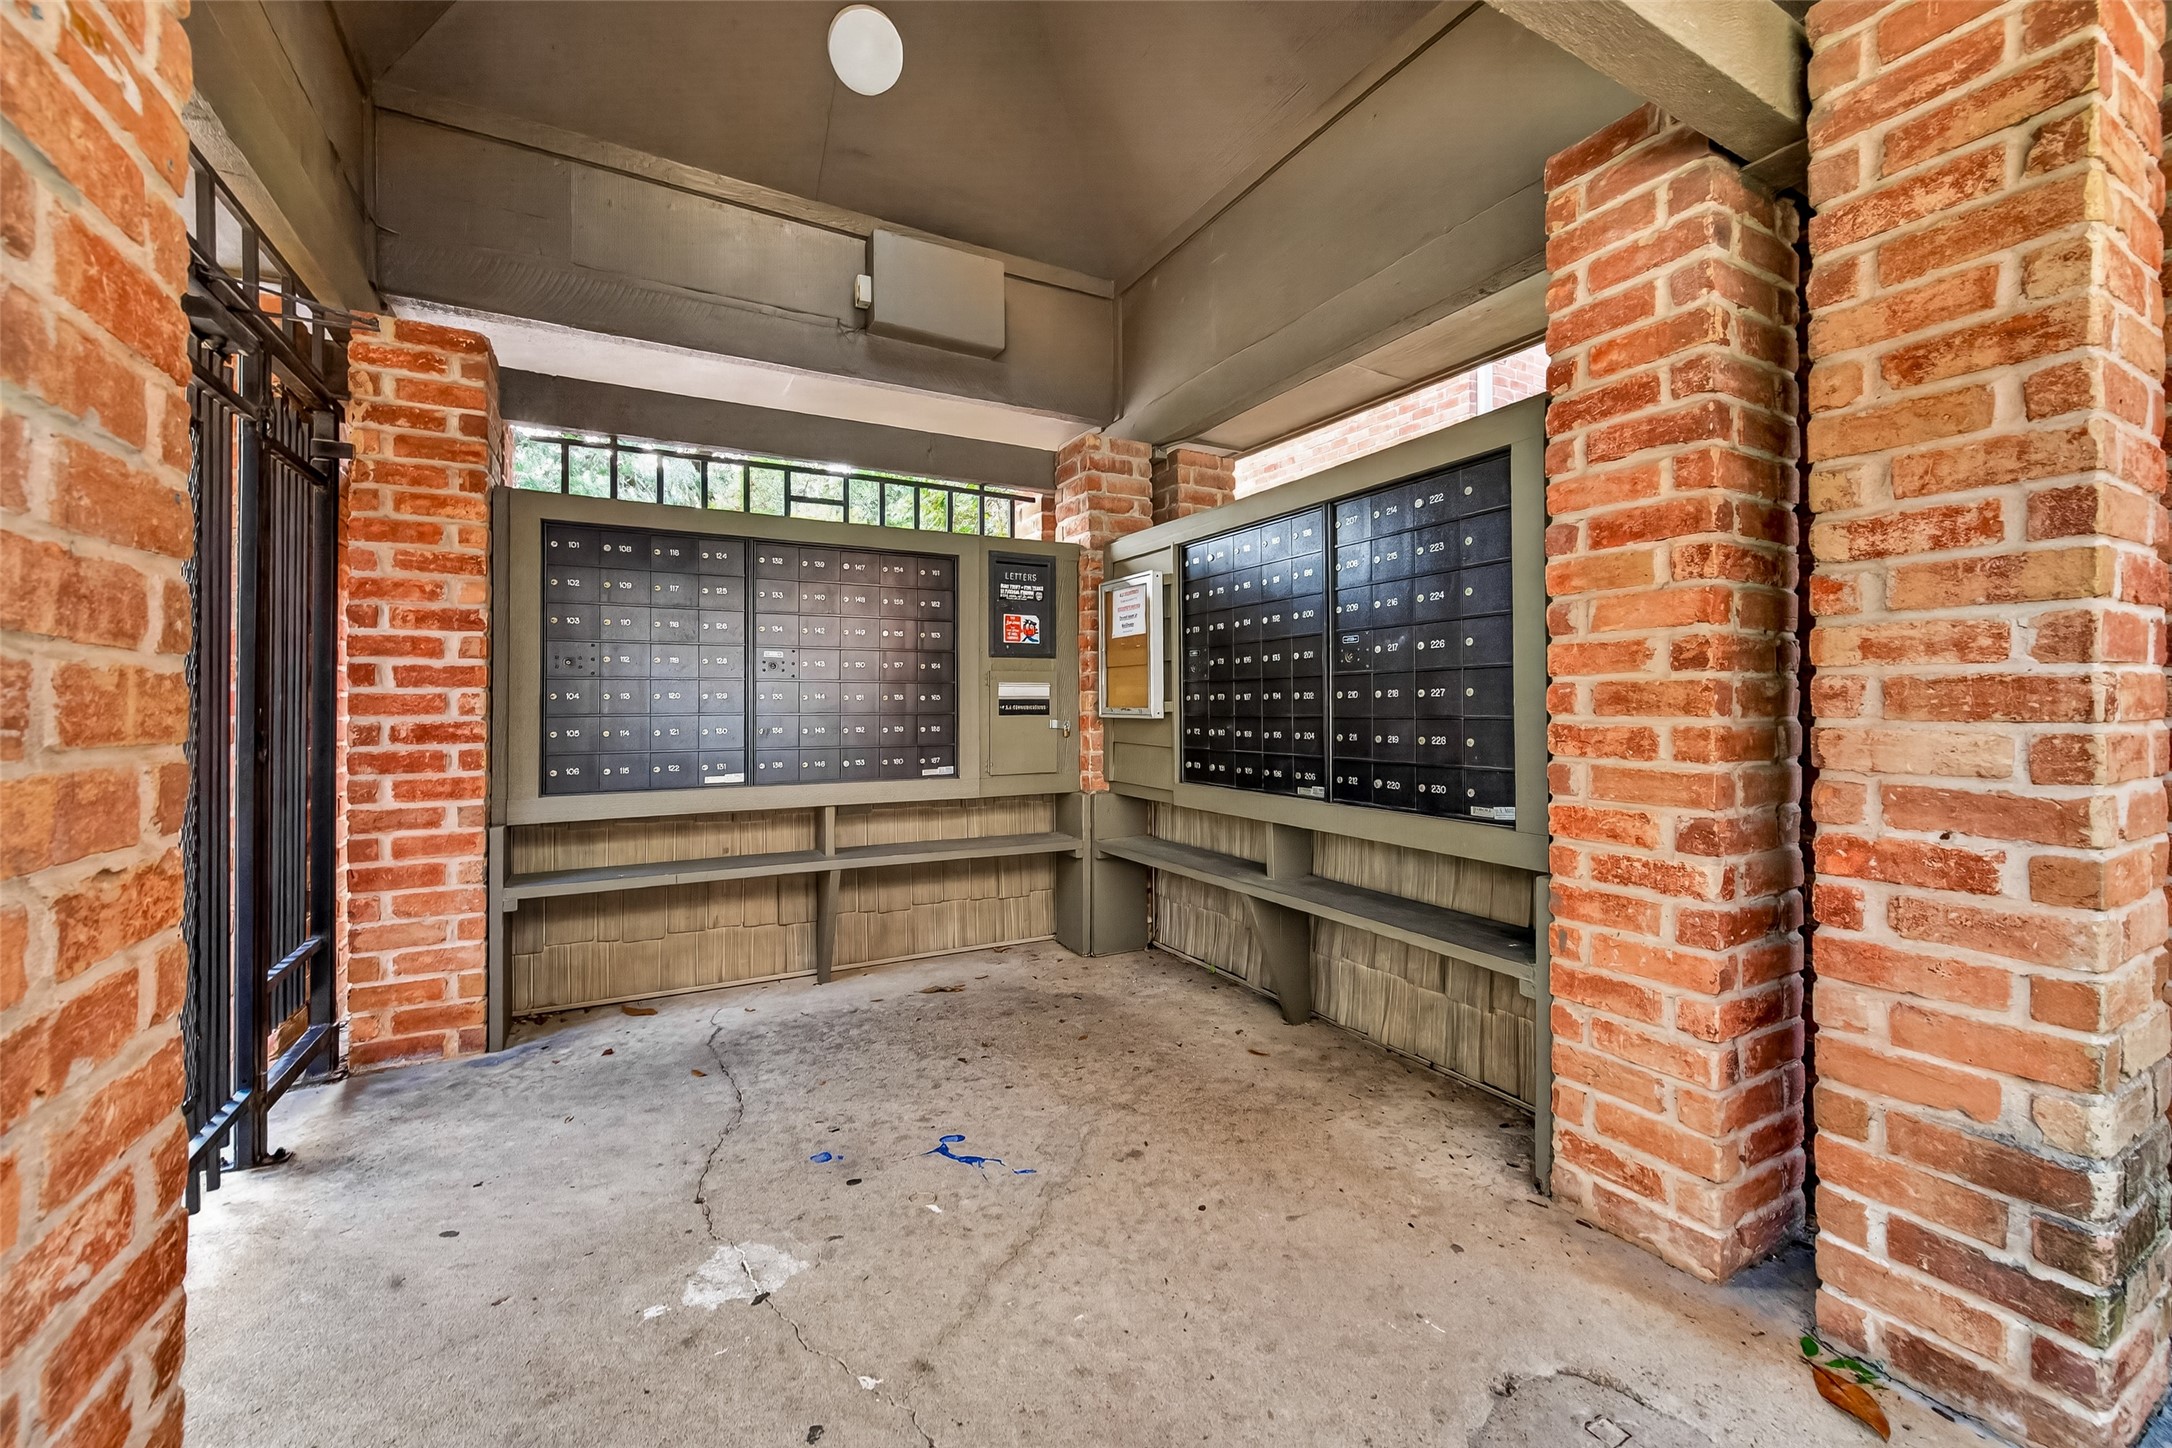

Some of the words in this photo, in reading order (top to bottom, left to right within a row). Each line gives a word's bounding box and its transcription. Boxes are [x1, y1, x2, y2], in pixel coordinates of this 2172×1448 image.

[1429, 493, 1444, 505] 222
[1385, 506, 1398, 516] 214
[1344, 515, 1358, 526] 207
[568, 541, 580, 549] 101
[618, 545, 632, 553] 108
[1429, 541, 1445, 553] 223
[669, 548, 680, 557] 116
[715, 552, 728, 560] 124
[1004, 571, 1037, 582] LETTERS
[567, 578, 580, 587] 102
[619, 581, 632, 589] 109
[716, 587, 728, 595] 125
[1429, 591, 1445, 601] 224
[1386, 597, 1399, 607] 216
[1346, 603, 1359, 613] 209
[1302, 609, 1314, 619] 200
[566, 616, 580, 625] 103
[620, 618, 632, 626] 110
[1387, 642, 1399, 652] 217
[1430, 639, 1446, 649] 226
[620, 655, 630, 663] 112
[566, 692, 580, 700] 104
[668, 692, 681, 700] 120
[1303, 691, 1315, 700] 202
[1347, 690, 1359, 699] 210
[1387, 689, 1399, 698] 218
[1430, 688, 1446, 698] 227
[566, 729, 580, 738] 105
[619, 729, 630, 737] 114
[669, 728, 680, 736] 121
[715, 727, 728, 735] 130
[1303, 731, 1315, 740] 204
[1387, 735, 1400, 744] 219
[1431, 735, 1447, 745] 228
[566, 767, 580, 776] 106
[619, 766, 630, 775] 115
[667, 764, 680, 772] 122
[1386, 780, 1401, 790] 220
[1430, 784, 1447, 794] 230
